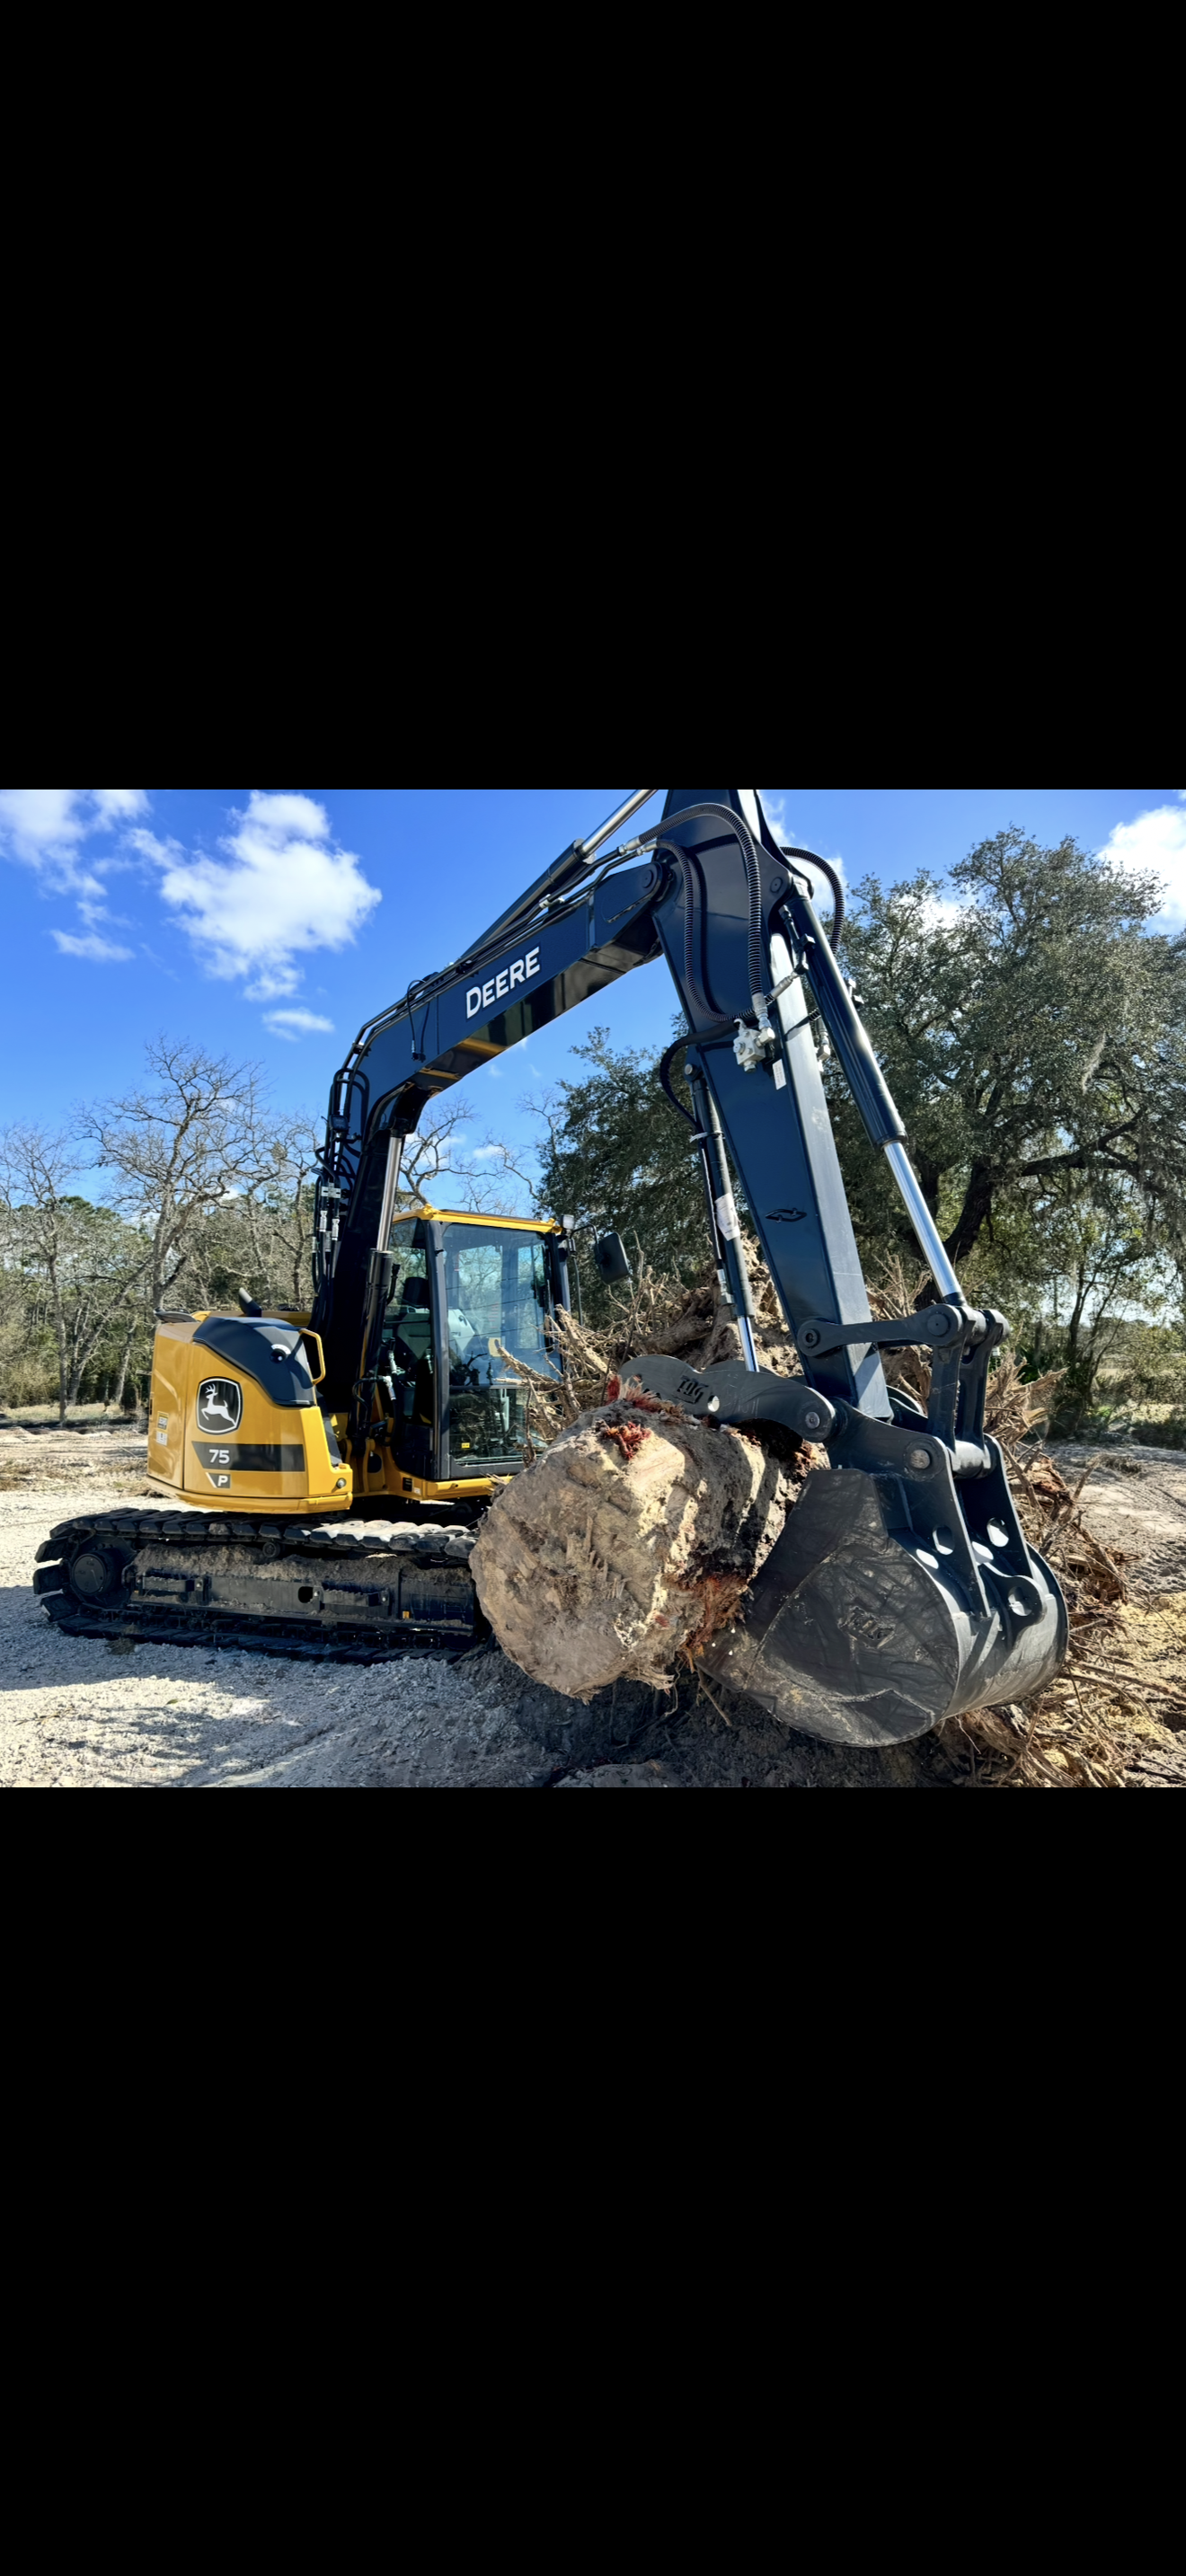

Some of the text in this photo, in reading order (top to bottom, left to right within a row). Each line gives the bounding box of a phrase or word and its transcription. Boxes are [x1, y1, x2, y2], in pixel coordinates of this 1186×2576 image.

[465, 946, 541, 1019] DEERE
[208, 1448, 231, 1464] 75
[217, 1475, 229, 1487] P
